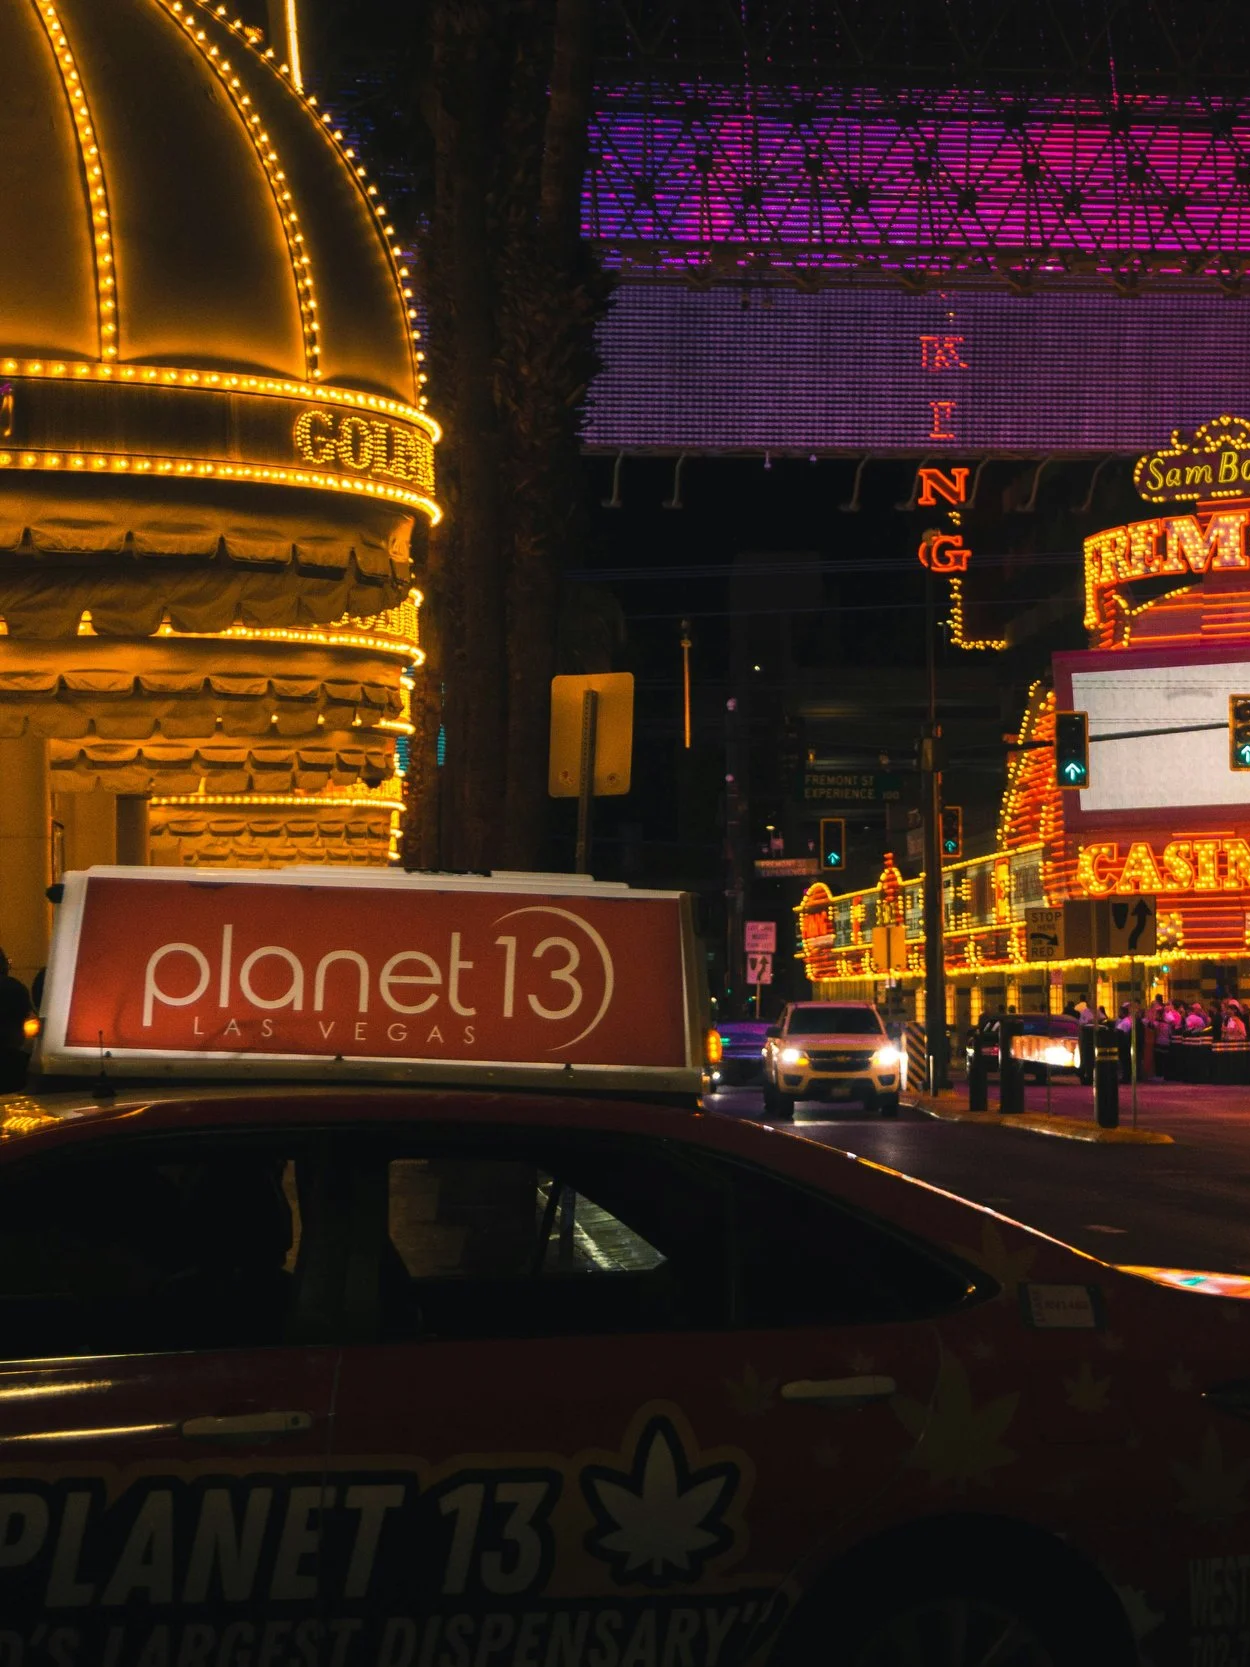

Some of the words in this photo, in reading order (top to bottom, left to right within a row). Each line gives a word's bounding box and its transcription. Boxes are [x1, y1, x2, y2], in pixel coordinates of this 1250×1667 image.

[1145, 458, 1212, 491] Sam
[804, 774, 857, 786] FREMONT
[861, 776, 875, 787] ST
[804, 787, 876, 800] EXPERIENCE
[1032, 911, 1062, 922] STOP
[1032, 946, 1054, 958] RED
[143, 924, 477, 1027] planet
[494, 935, 583, 1020] 13
[193, 1015, 274, 1037] LAS
[319, 1019, 477, 1044] VEGAS
[0, 1484, 406, 1608] PLANET
[440, 1482, 551, 1596] 13
